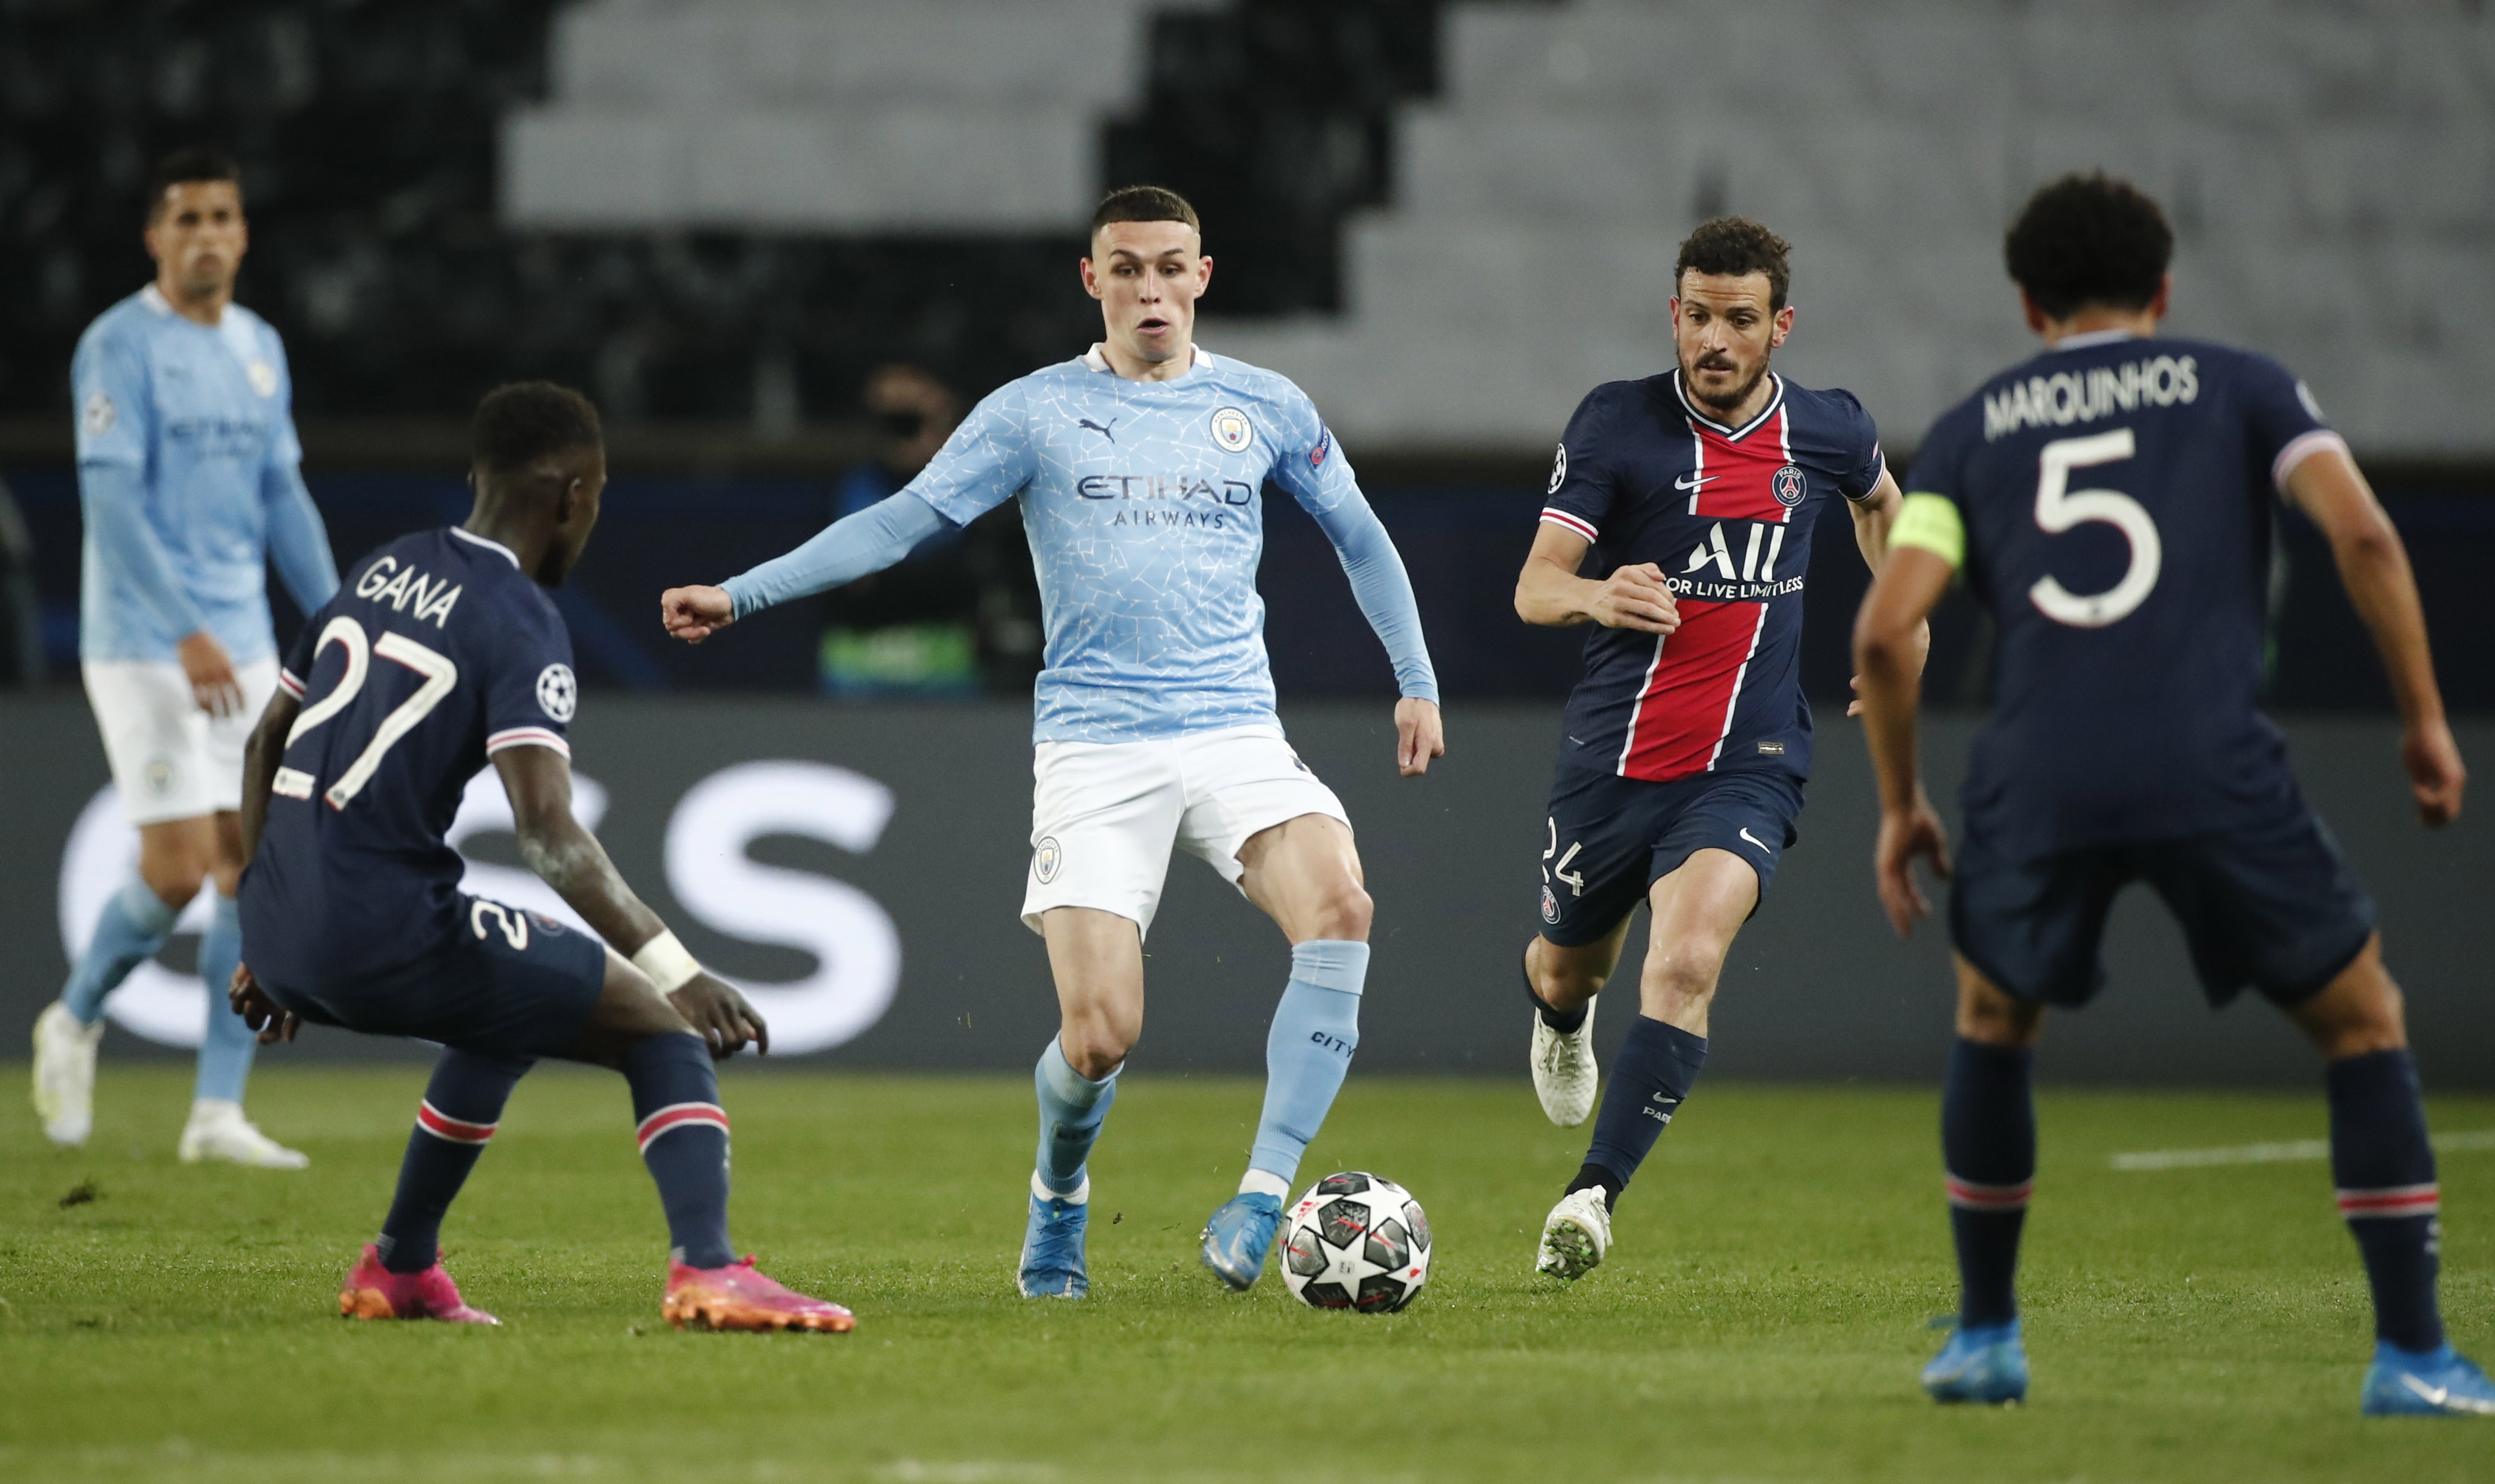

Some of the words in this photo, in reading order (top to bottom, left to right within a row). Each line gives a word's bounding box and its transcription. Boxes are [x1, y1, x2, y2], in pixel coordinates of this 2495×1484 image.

[1984, 355, 2198, 442] MARQUINHOS
[1214, 410, 1248, 425] MANCHESTER
[1779, 469, 1801, 479] PARIS
[1077, 475, 1252, 506] ETIHAD
[1114, 510, 1223, 529] AIRWAYS
[2028, 427, 2162, 628] 5
[355, 556, 463, 629] GANA
[1664, 577, 1692, 594] OR
[1697, 581, 1737, 598] LIVE
[1740, 575, 1804, 598] LIMITLESS
[272, 615, 458, 812] 27
[1311, 1031, 1356, 1058] CITY
